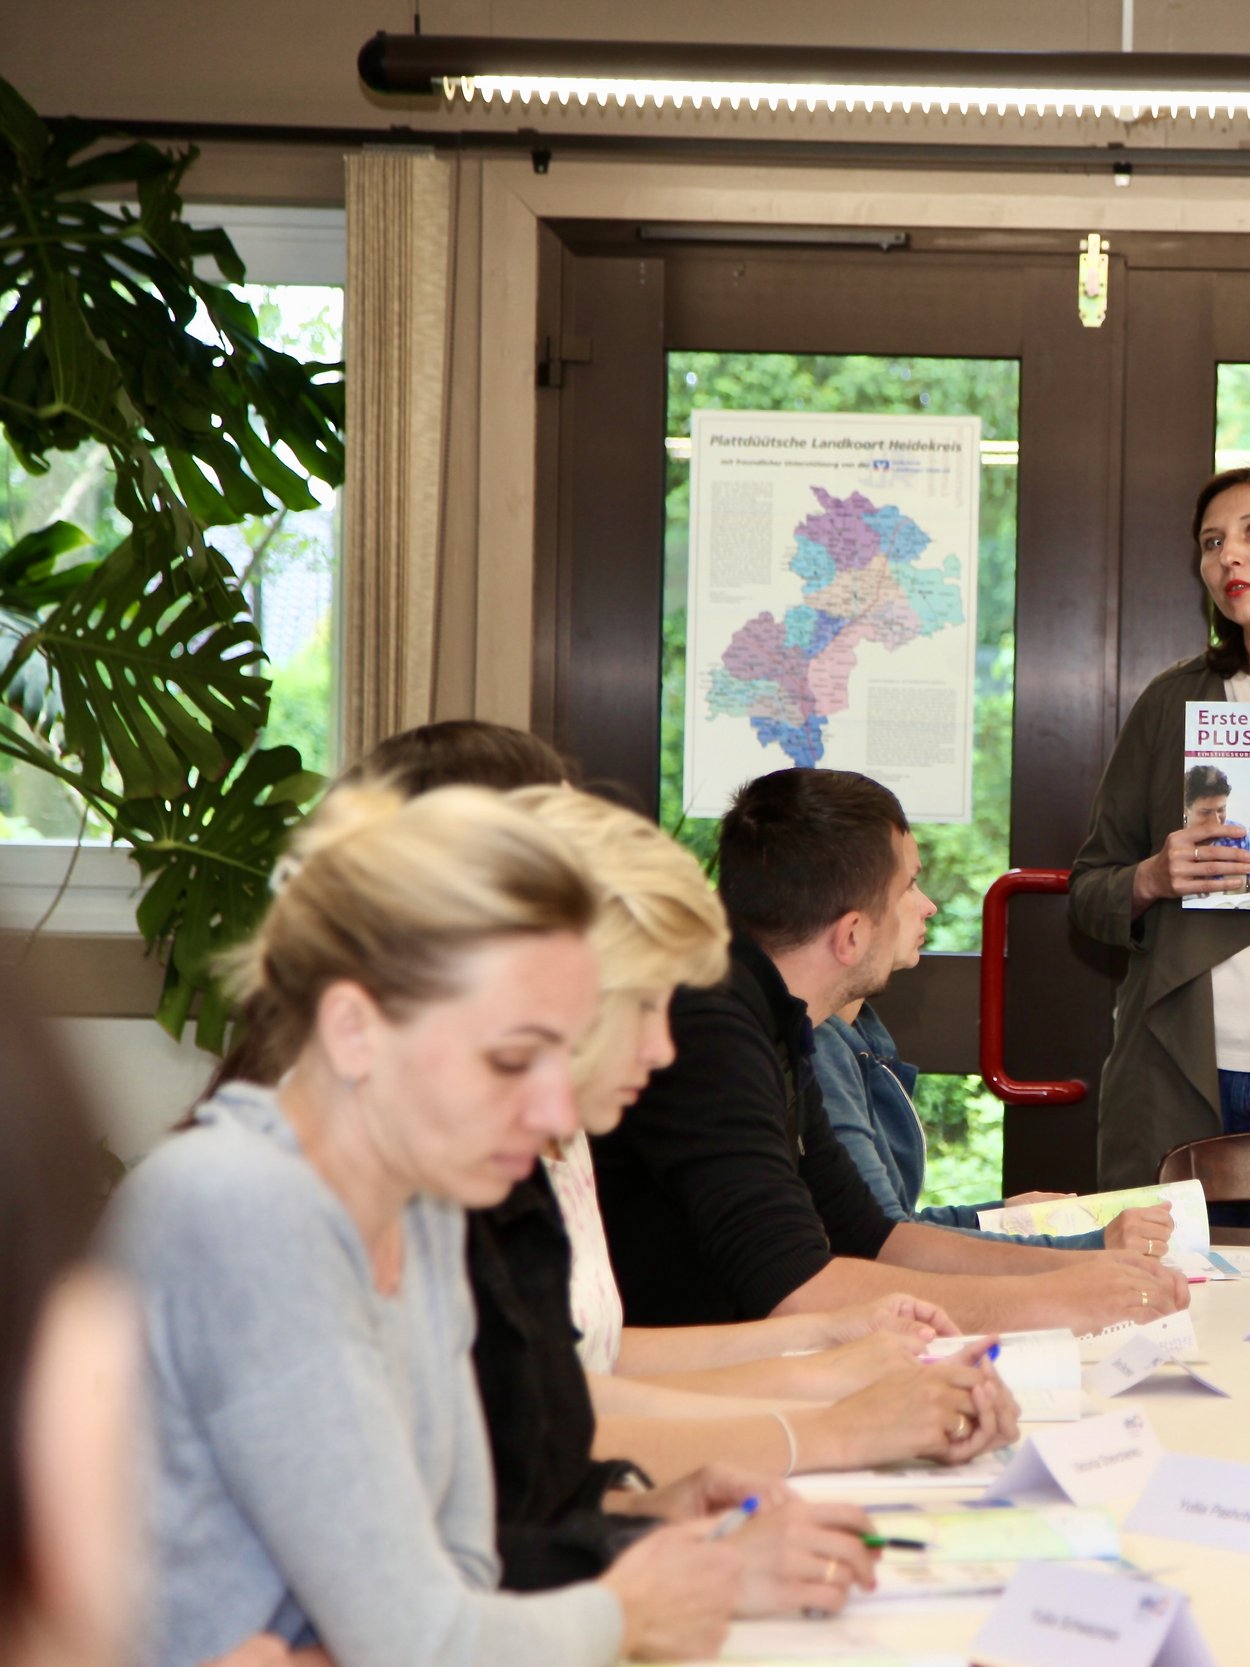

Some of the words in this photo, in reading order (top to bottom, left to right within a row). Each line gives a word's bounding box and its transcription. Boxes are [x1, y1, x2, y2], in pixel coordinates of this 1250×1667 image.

[709, 434, 807, 449] Plattdüütsche
[811, 436, 885, 451] Landkoort
[888, 438, 963, 453] Heidekreis
[1197, 709, 1249, 726] Erste
